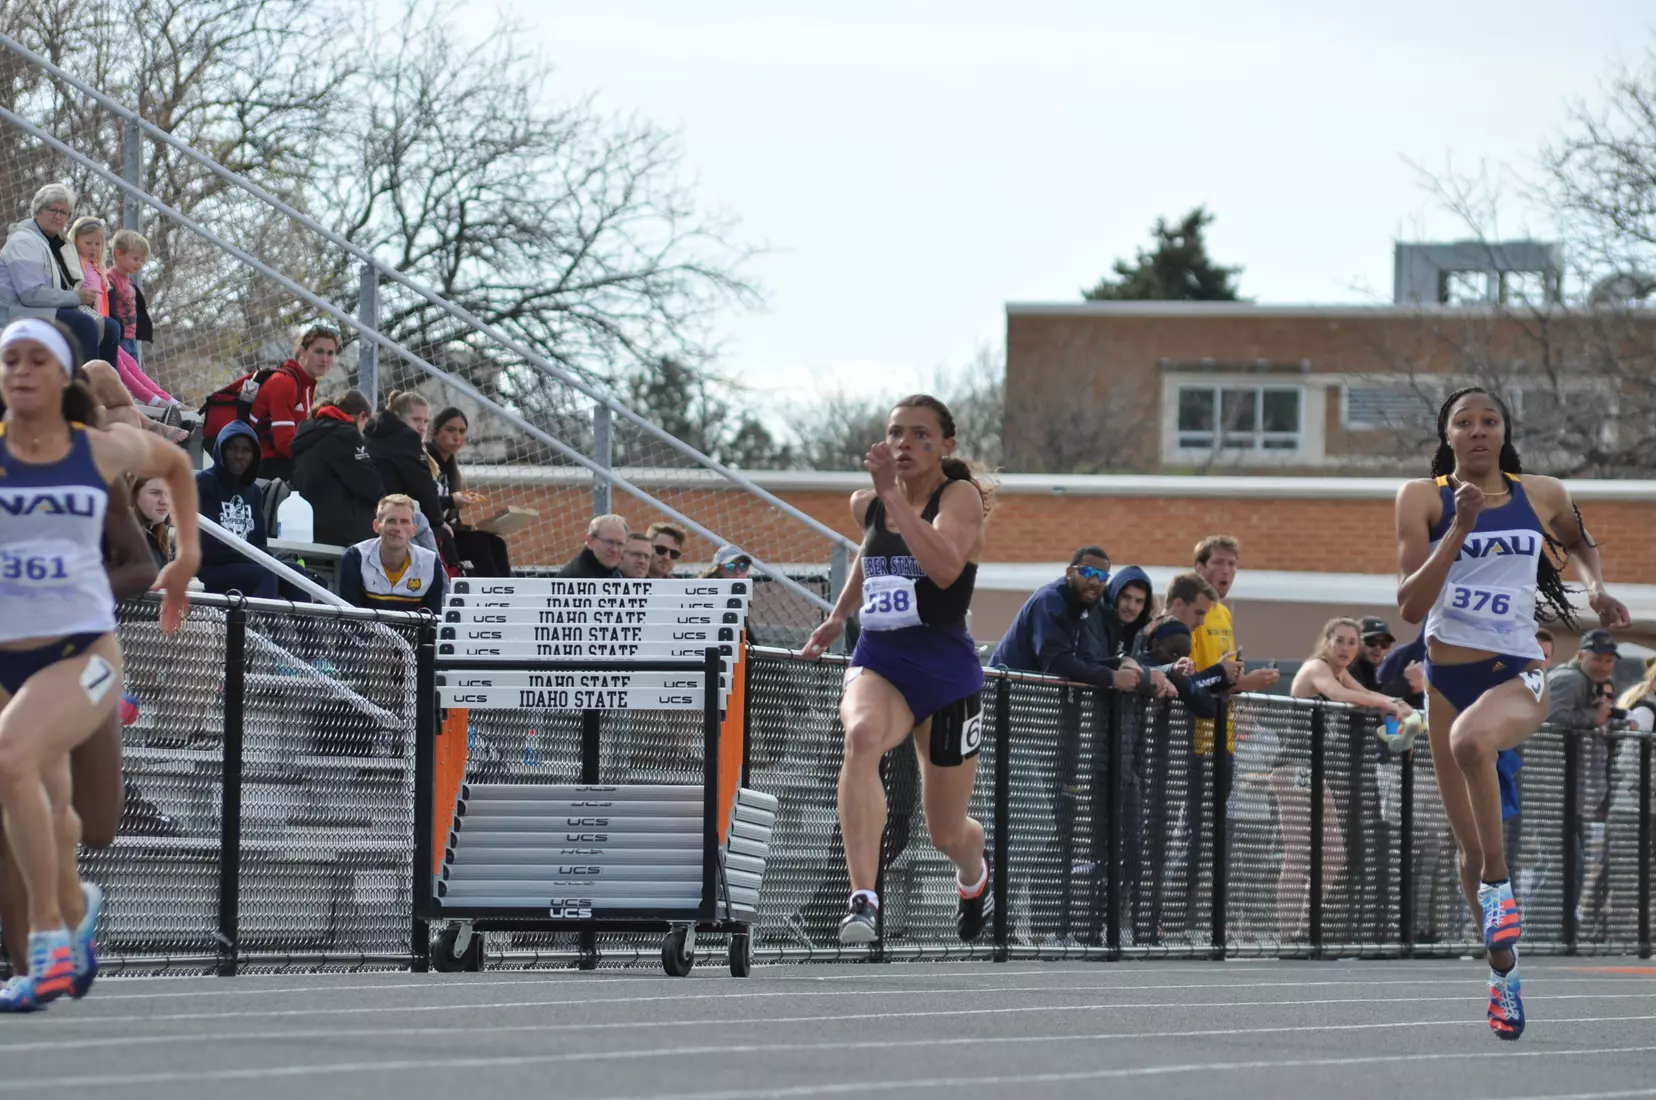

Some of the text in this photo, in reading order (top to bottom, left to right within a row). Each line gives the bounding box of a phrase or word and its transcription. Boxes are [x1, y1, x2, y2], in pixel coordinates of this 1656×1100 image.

[1454, 535, 1535, 562] NAU
[3, 555, 69, 580] 361
[481, 582, 719, 595] UCS IDAHO STATE UCS
[1452, 587, 1511, 615] 376
[473, 611, 711, 624] UCS IDAHO STATE UCS
[468, 627, 707, 641] UCS IDAHO STATE UCS
[453, 690, 693, 708] UCS IDAHO STATE UCS
[966, 718, 980, 748] 6
[567, 818, 609, 827] UCS
[566, 834, 608, 842] UCS
[559, 866, 601, 875] UCS
[550, 899, 593, 907] UCS
[549, 907, 593, 919] UCS
